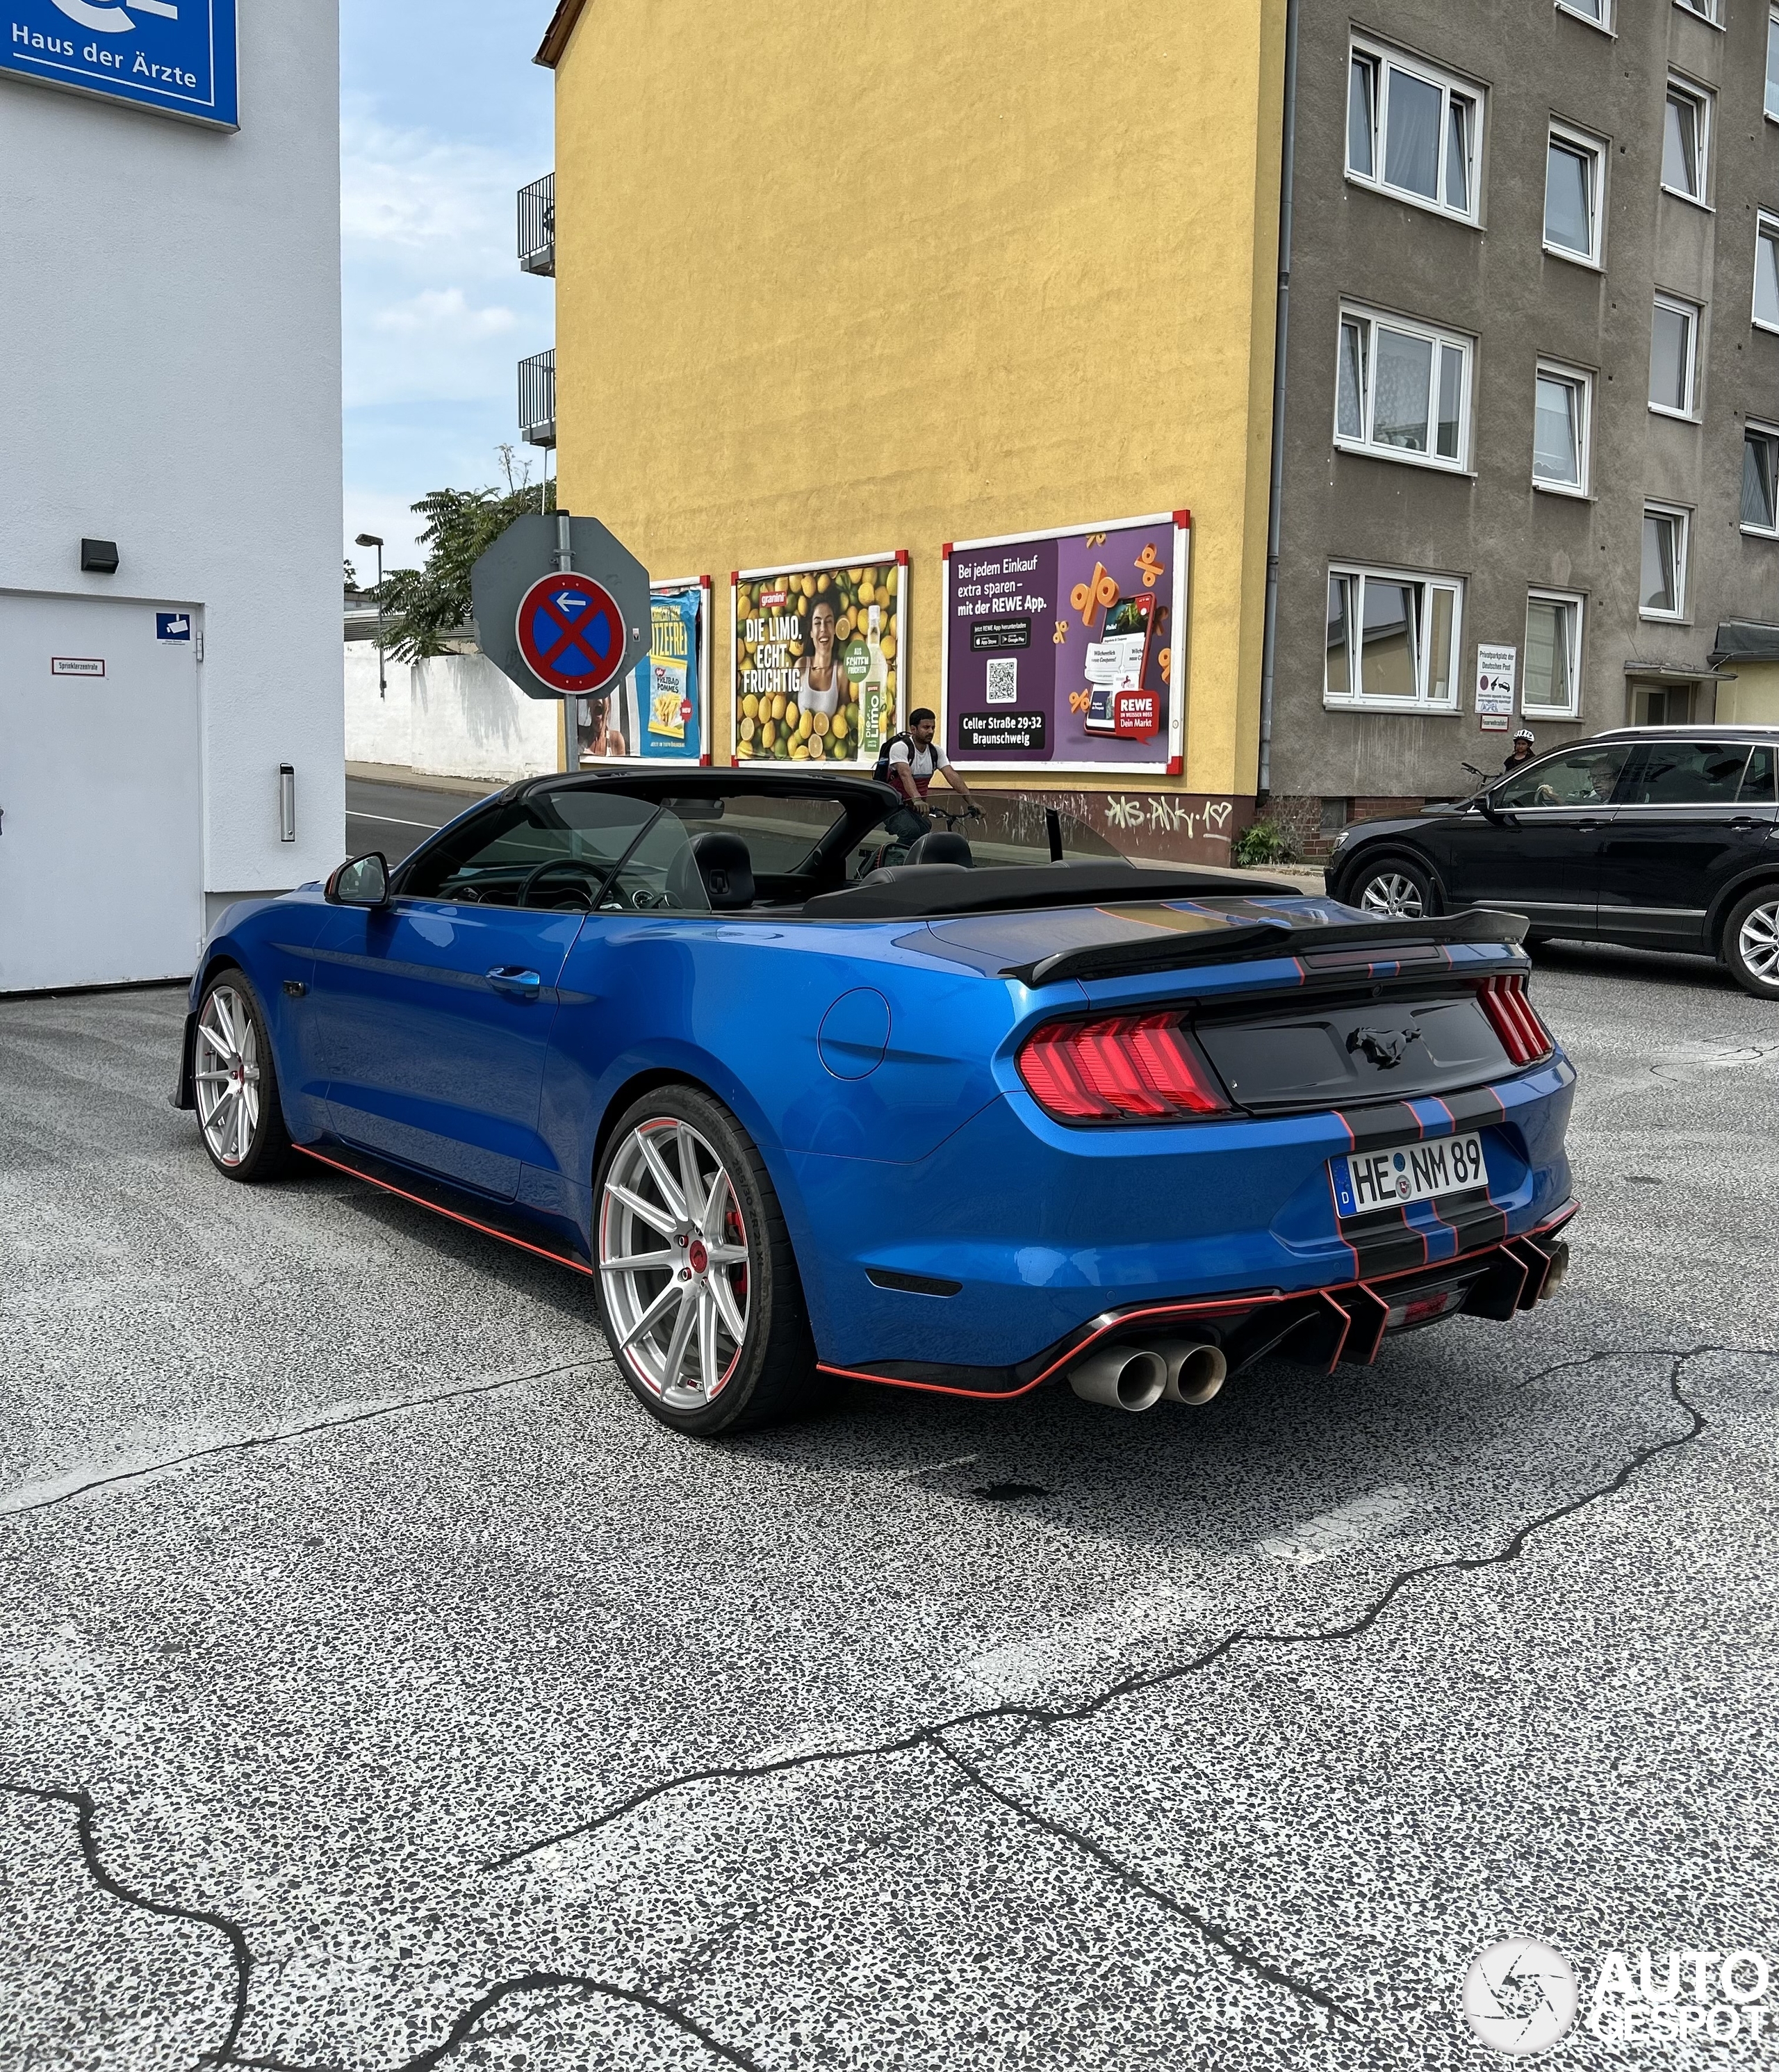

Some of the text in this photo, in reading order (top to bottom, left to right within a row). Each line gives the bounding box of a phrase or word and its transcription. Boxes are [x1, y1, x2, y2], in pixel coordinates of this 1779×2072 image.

[12, 23, 197, 88] Haus der Ärzte
[958, 555, 1038, 581] Bei jedem Einkauf
[958, 585, 981, 597] extra
[984, 581, 1015, 598] sparen
[762, 592, 785, 606] granini
[958, 595, 1047, 617] mit der REWE App.
[746, 615, 802, 642] DIE LIMO.
[757, 644, 789, 668] ECHT.
[854, 647, 862, 655] AUS
[59, 662, 98, 671] Sprinklerzentrale
[846, 657, 869, 667] ECHTEN
[657, 683, 679, 694] POMMES
[744, 669, 803, 693] FRUCHTIG.
[1120, 698, 1153, 712] REWE
[871, 695, 879, 738] Limo
[963, 717, 987, 729] Celler
[987, 717, 1016, 729] Straße
[1120, 719, 1152, 728] Dein Markt
[973, 731, 1030, 747] Braunschweig
[1352, 1139, 1480, 1204] HE NM 89
[732, 1157, 753, 1207] 285/30
[1341, 1191, 1350, 1204] D
